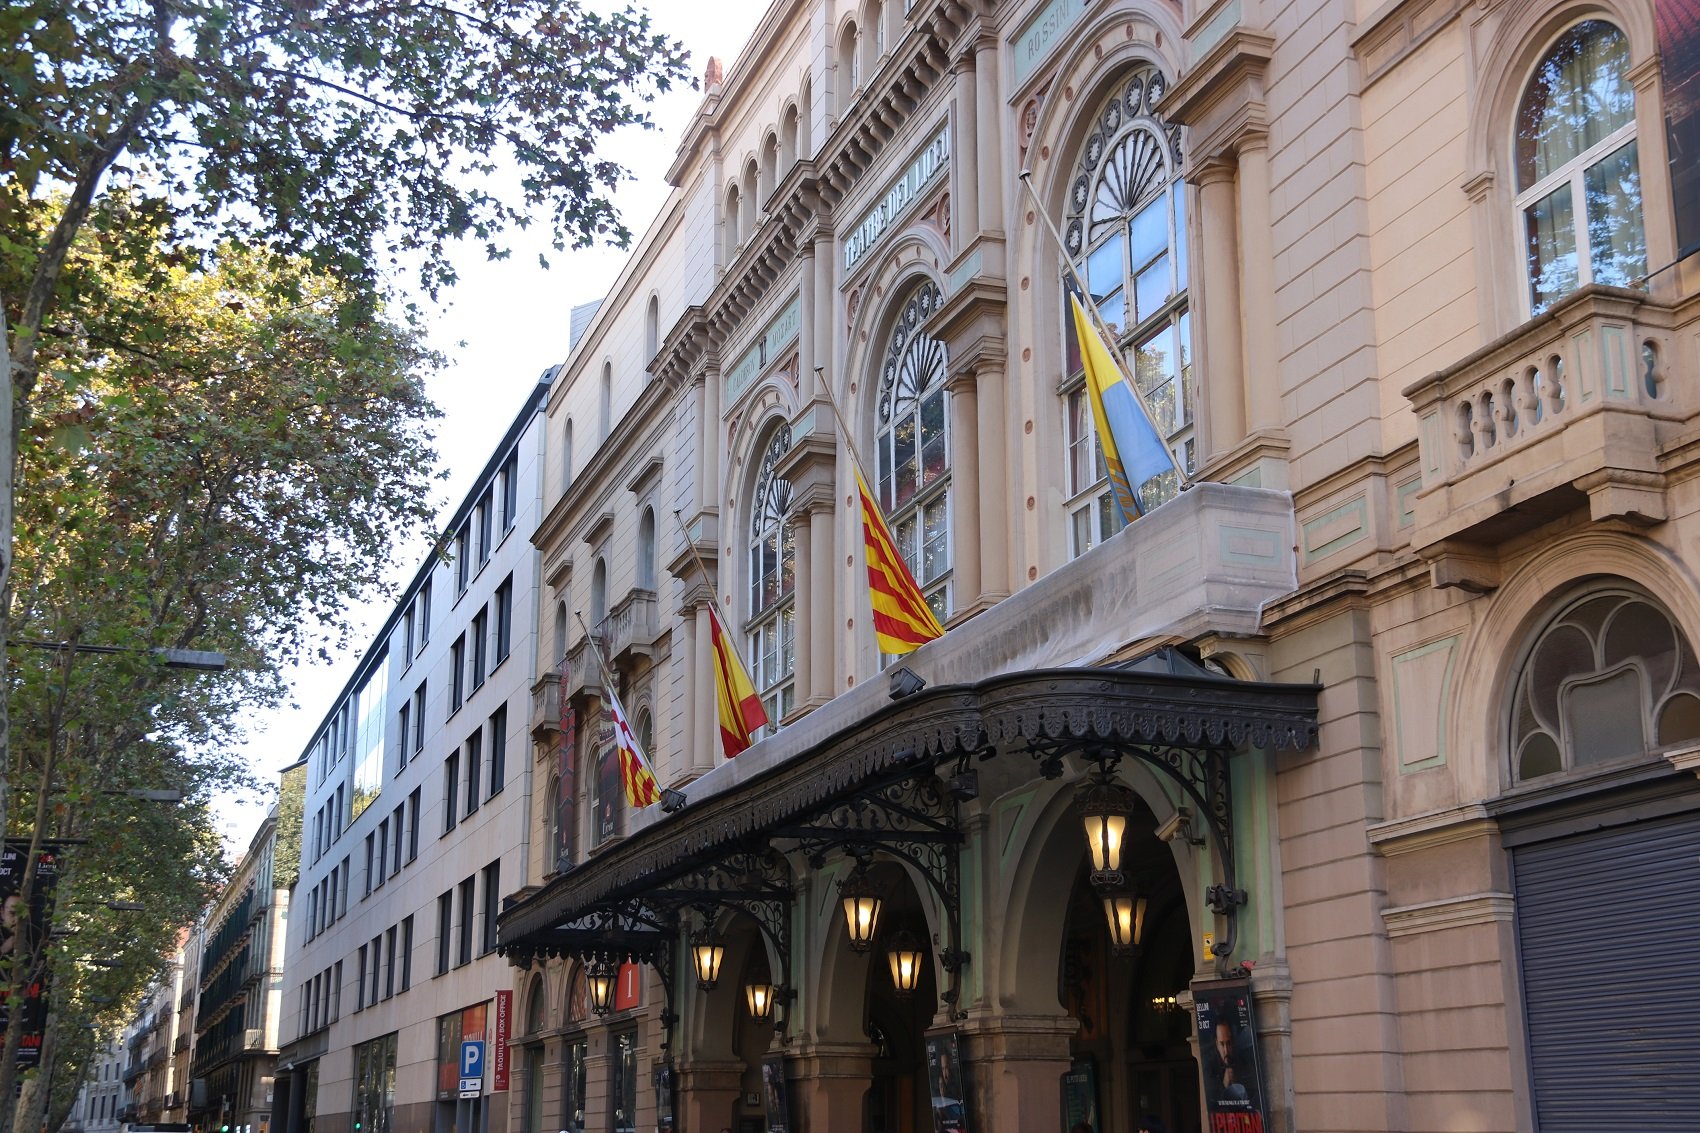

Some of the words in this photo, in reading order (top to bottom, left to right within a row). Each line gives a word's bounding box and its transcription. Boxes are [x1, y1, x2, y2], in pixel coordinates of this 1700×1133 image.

[1028, 0, 1069, 60] ROSSINI
[845, 200, 887, 271] TEATRE
[888, 173, 913, 224] DEL
[915, 125, 949, 194] LICEU
[772, 309, 797, 347] MOZART
[465, 1045, 479, 1073] P
